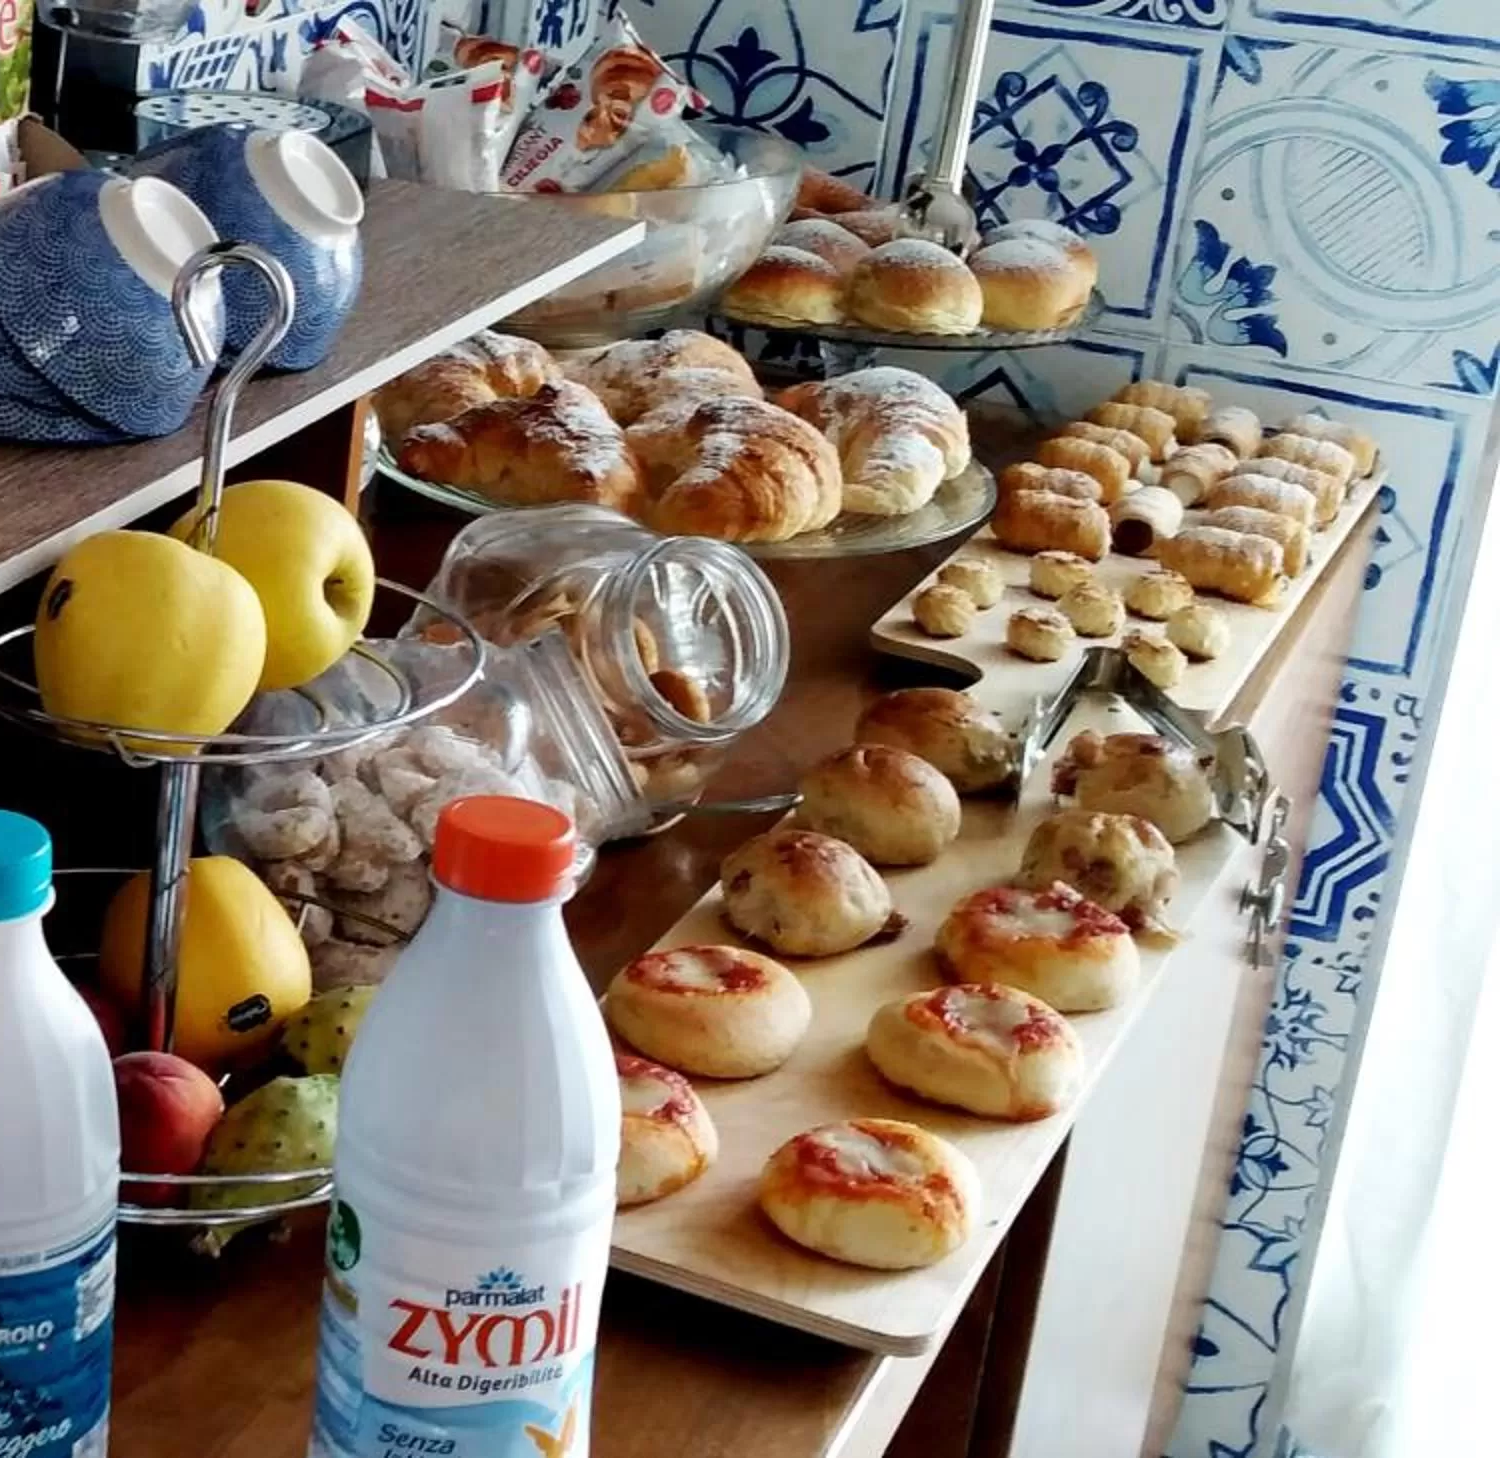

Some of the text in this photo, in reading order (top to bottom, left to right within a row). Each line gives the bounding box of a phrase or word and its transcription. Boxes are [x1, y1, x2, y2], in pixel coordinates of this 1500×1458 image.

[445, 1285, 546, 1308] parmalat
[408, 1366, 452, 1389] Alta
[377, 1423, 456, 1456] Senza
